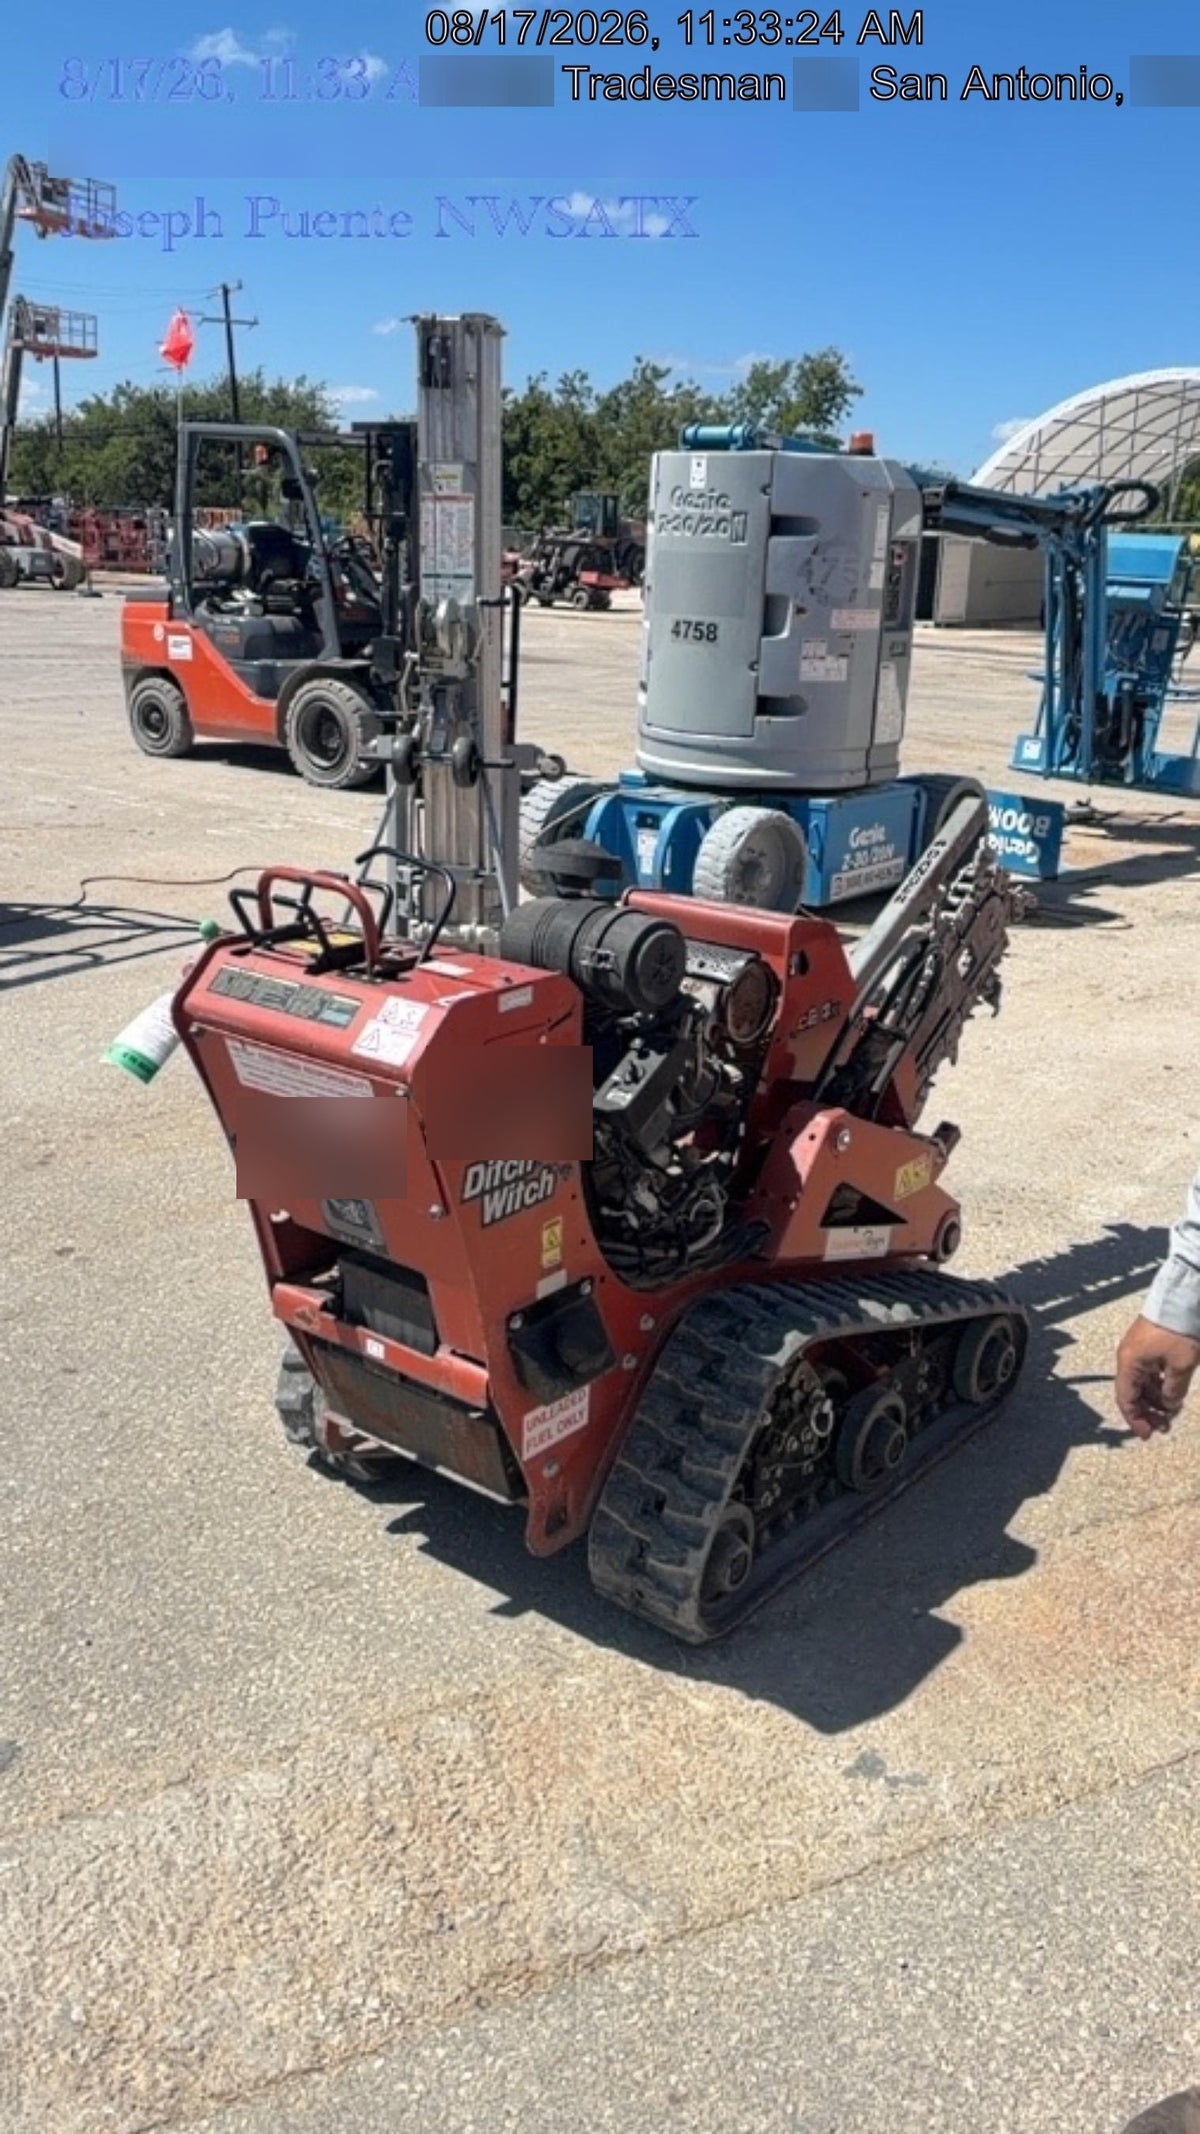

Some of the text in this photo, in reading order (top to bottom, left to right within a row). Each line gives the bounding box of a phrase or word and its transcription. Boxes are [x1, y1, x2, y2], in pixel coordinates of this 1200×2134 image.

[670, 620, 719, 643] 4758
[461, 1159, 534, 1202] Ditch
[482, 1168, 556, 1228] Witch
[526, 1388, 587, 1433] UNLEADED
[526, 1406, 586, 1454] FUEL ONLY
